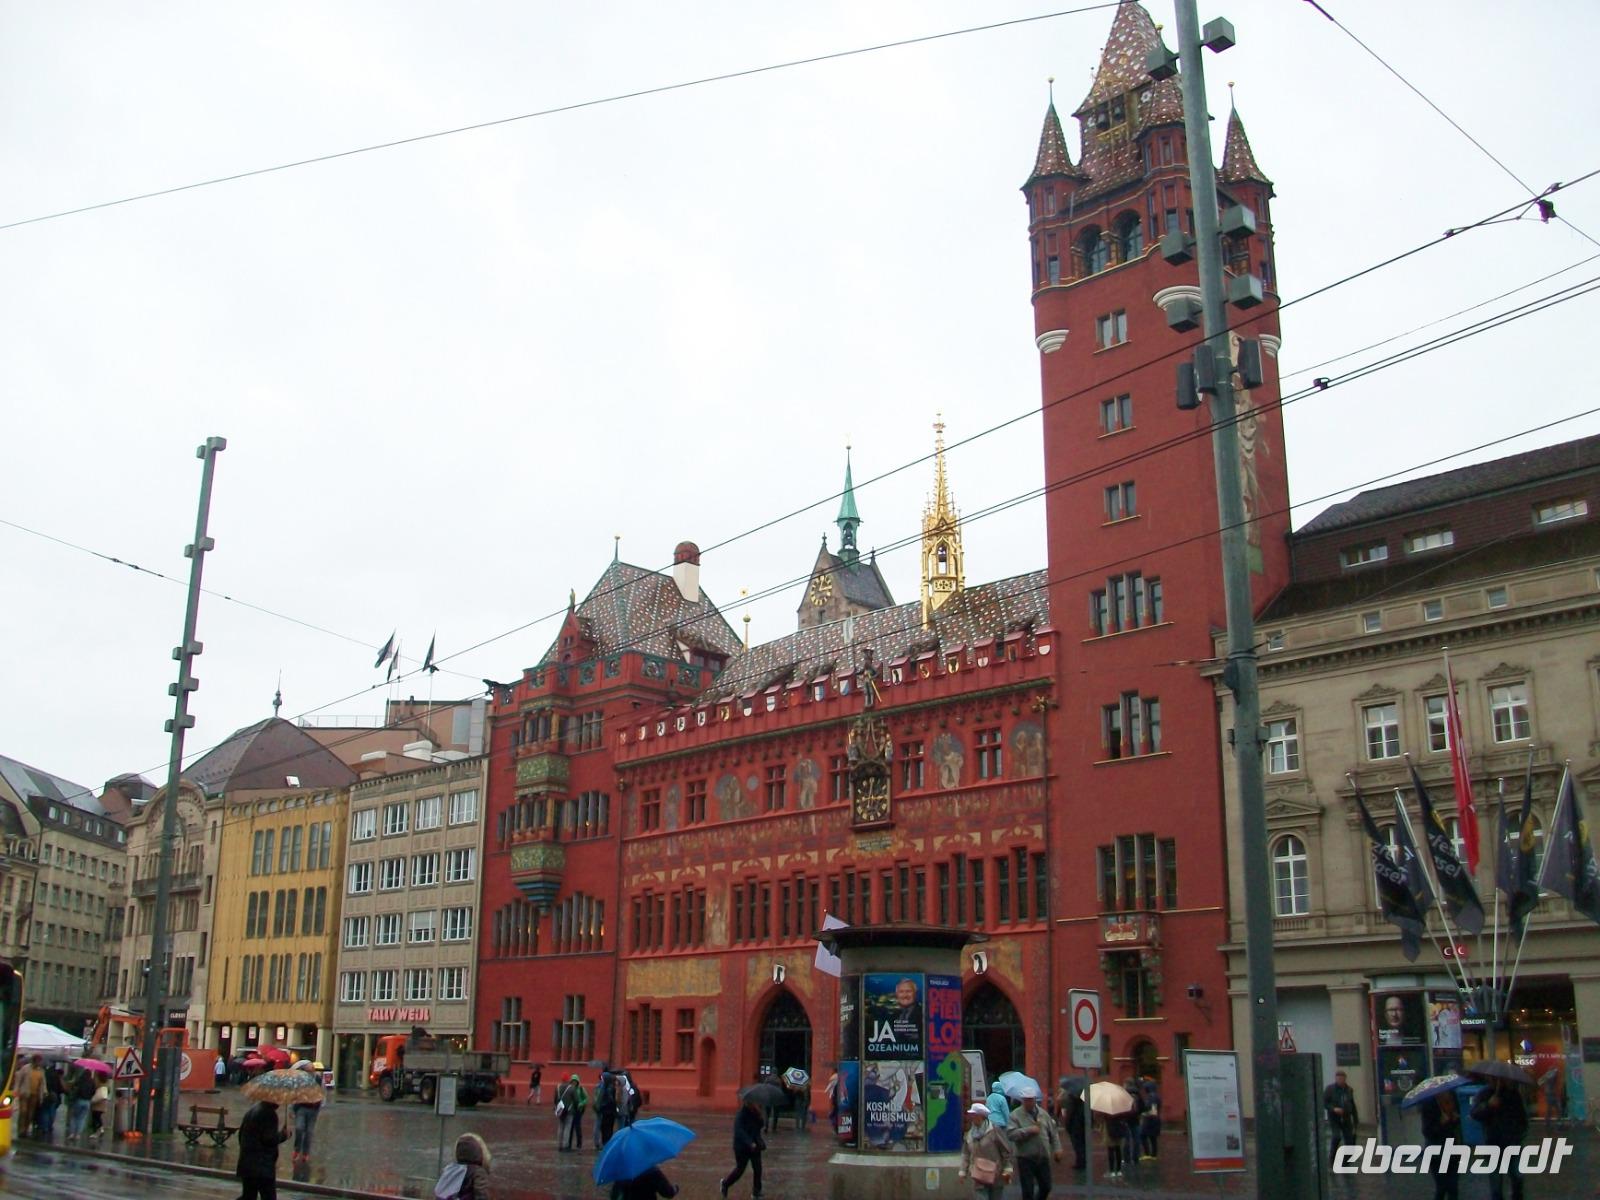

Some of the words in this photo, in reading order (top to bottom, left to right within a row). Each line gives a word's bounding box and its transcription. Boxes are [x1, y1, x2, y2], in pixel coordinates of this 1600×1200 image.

[368, 1008, 397, 1021] TALLY
[868, 1020, 896, 1043] JA
[867, 1043, 919, 1053] OZEANIUM
[870, 1112, 917, 1122] KUBISMUS
